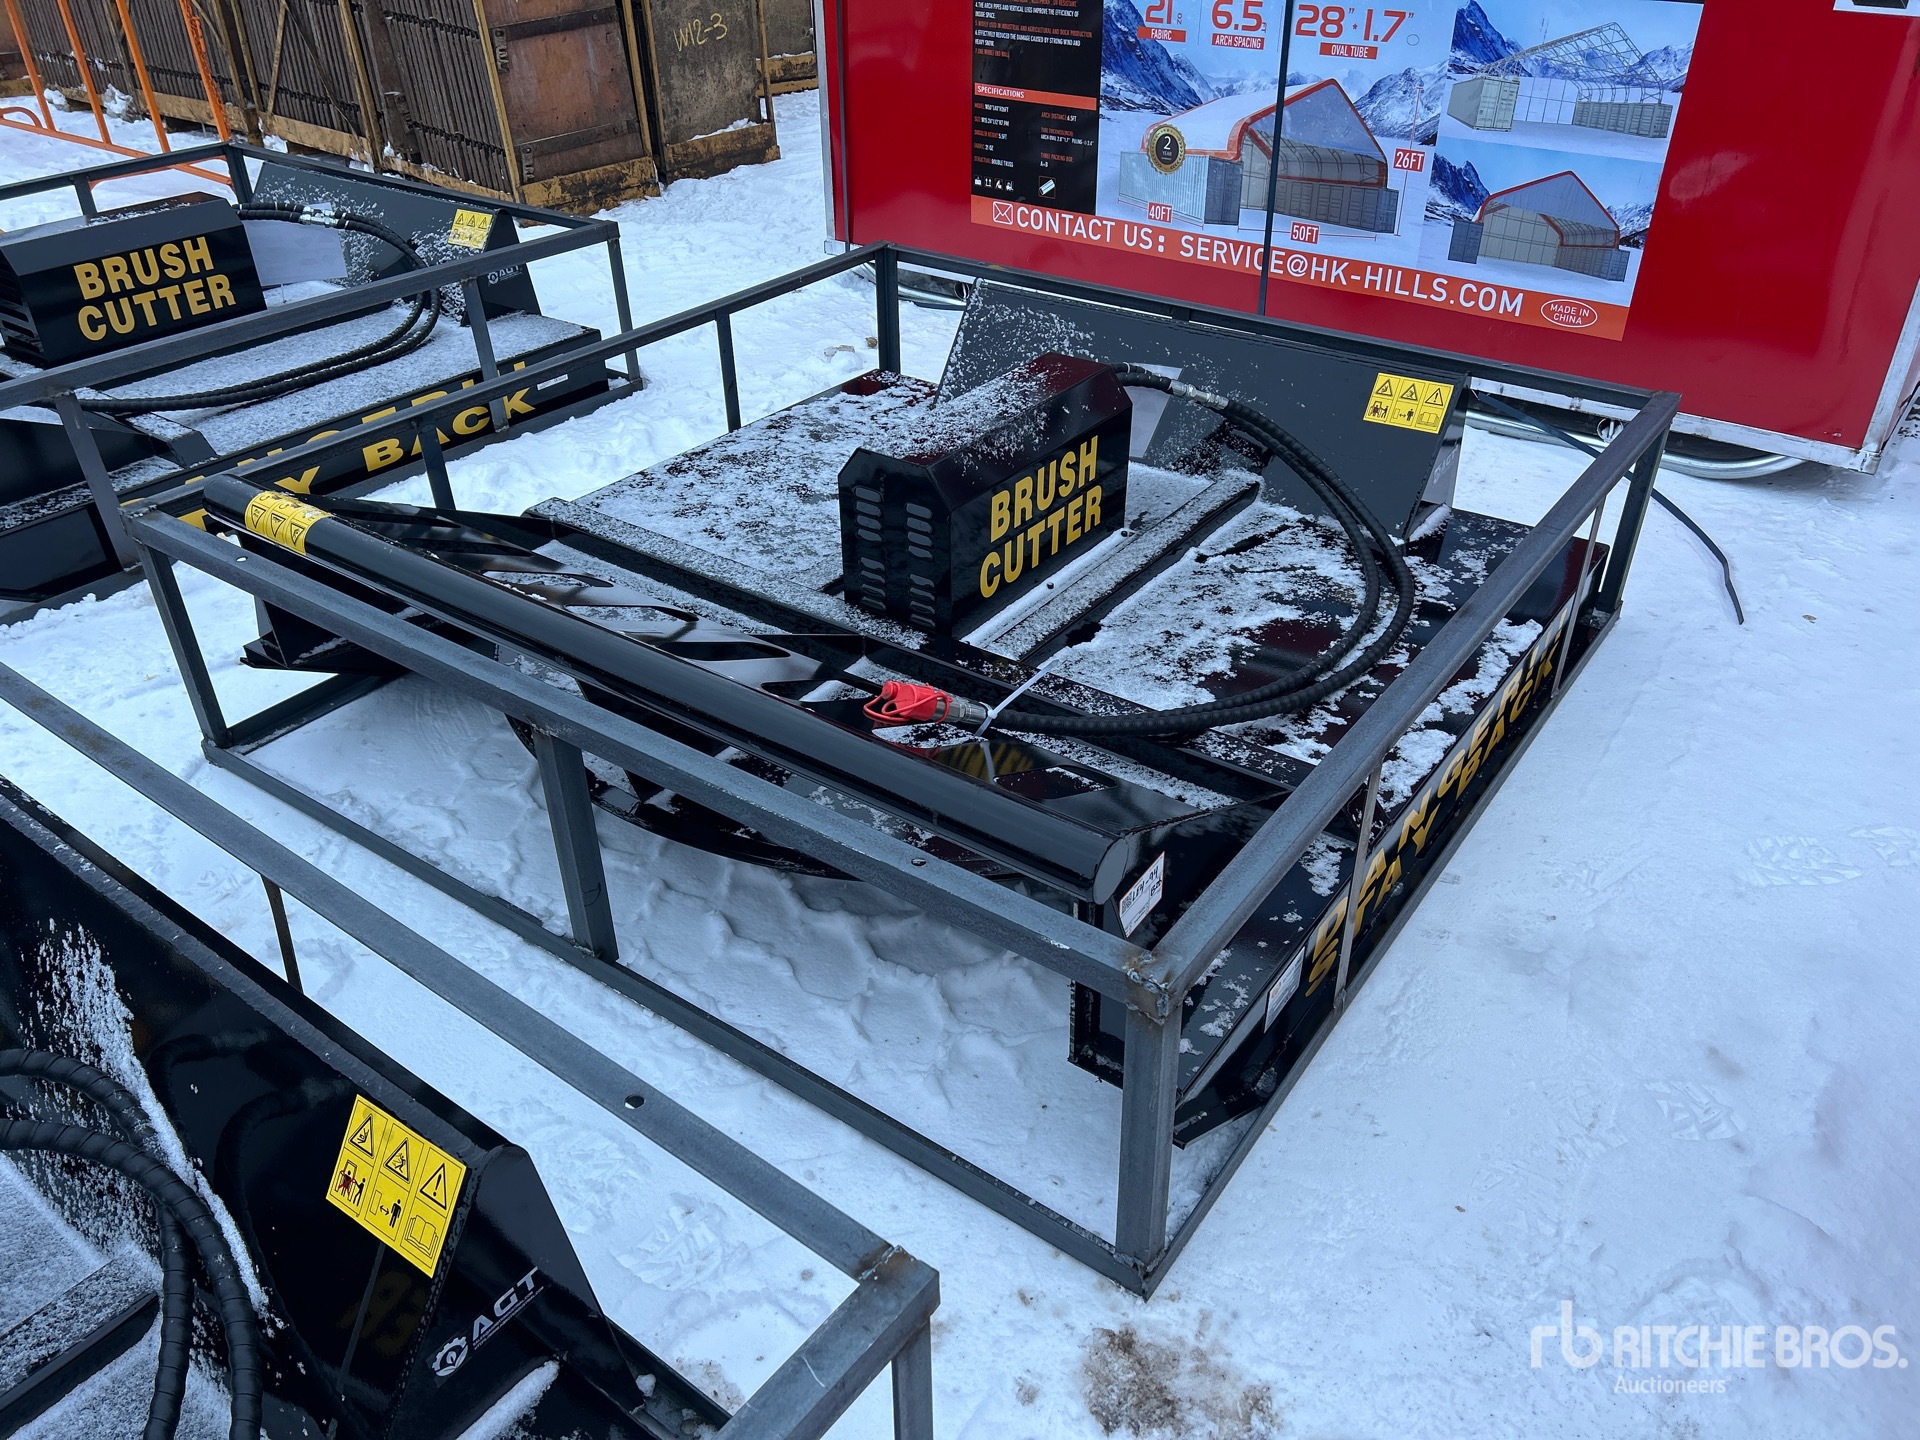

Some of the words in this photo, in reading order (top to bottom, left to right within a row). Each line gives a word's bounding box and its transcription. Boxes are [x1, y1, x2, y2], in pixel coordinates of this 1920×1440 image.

[1145, 0, 1173, 24] 21
[1212, 0, 1263, 32] 6.5
[1150, 28, 1172, 40] FABIRC
[1215, 35, 1232, 46] ARCH
[1234, 37, 1261, 49] SPACING
[1331, 44, 1348, 56] OVAL
[1351, 46, 1368, 58] TUBE
[978, 86, 1024, 98] SPECIFICATIONS
[1164, 136, 1171, 150] 2
[1395, 152, 1424, 170] 26FT
[1149, 204, 1172, 222] 40FT
[1293, 225, 1318, 242] 50FT
[73, 236, 214, 300] BRUSH
[1016, 206, 1115, 242] CONTACT
[1124, 224, 1164, 253] US:
[1179, 234, 1524, 317] SERVICE@HK-HILLS.COM
[78, 274, 238, 342] CUTTER
[1550, 304, 1576, 315] MADE
[1577, 307, 1590, 317] IN
[1553, 313, 1582, 325] CHINA
[990, 434, 1099, 544] BRUSH
[980, 484, 1102, 600] CUTTER
[1456, 640, 1560, 800] BACK
[472, 1266, 538, 1342] AGT
